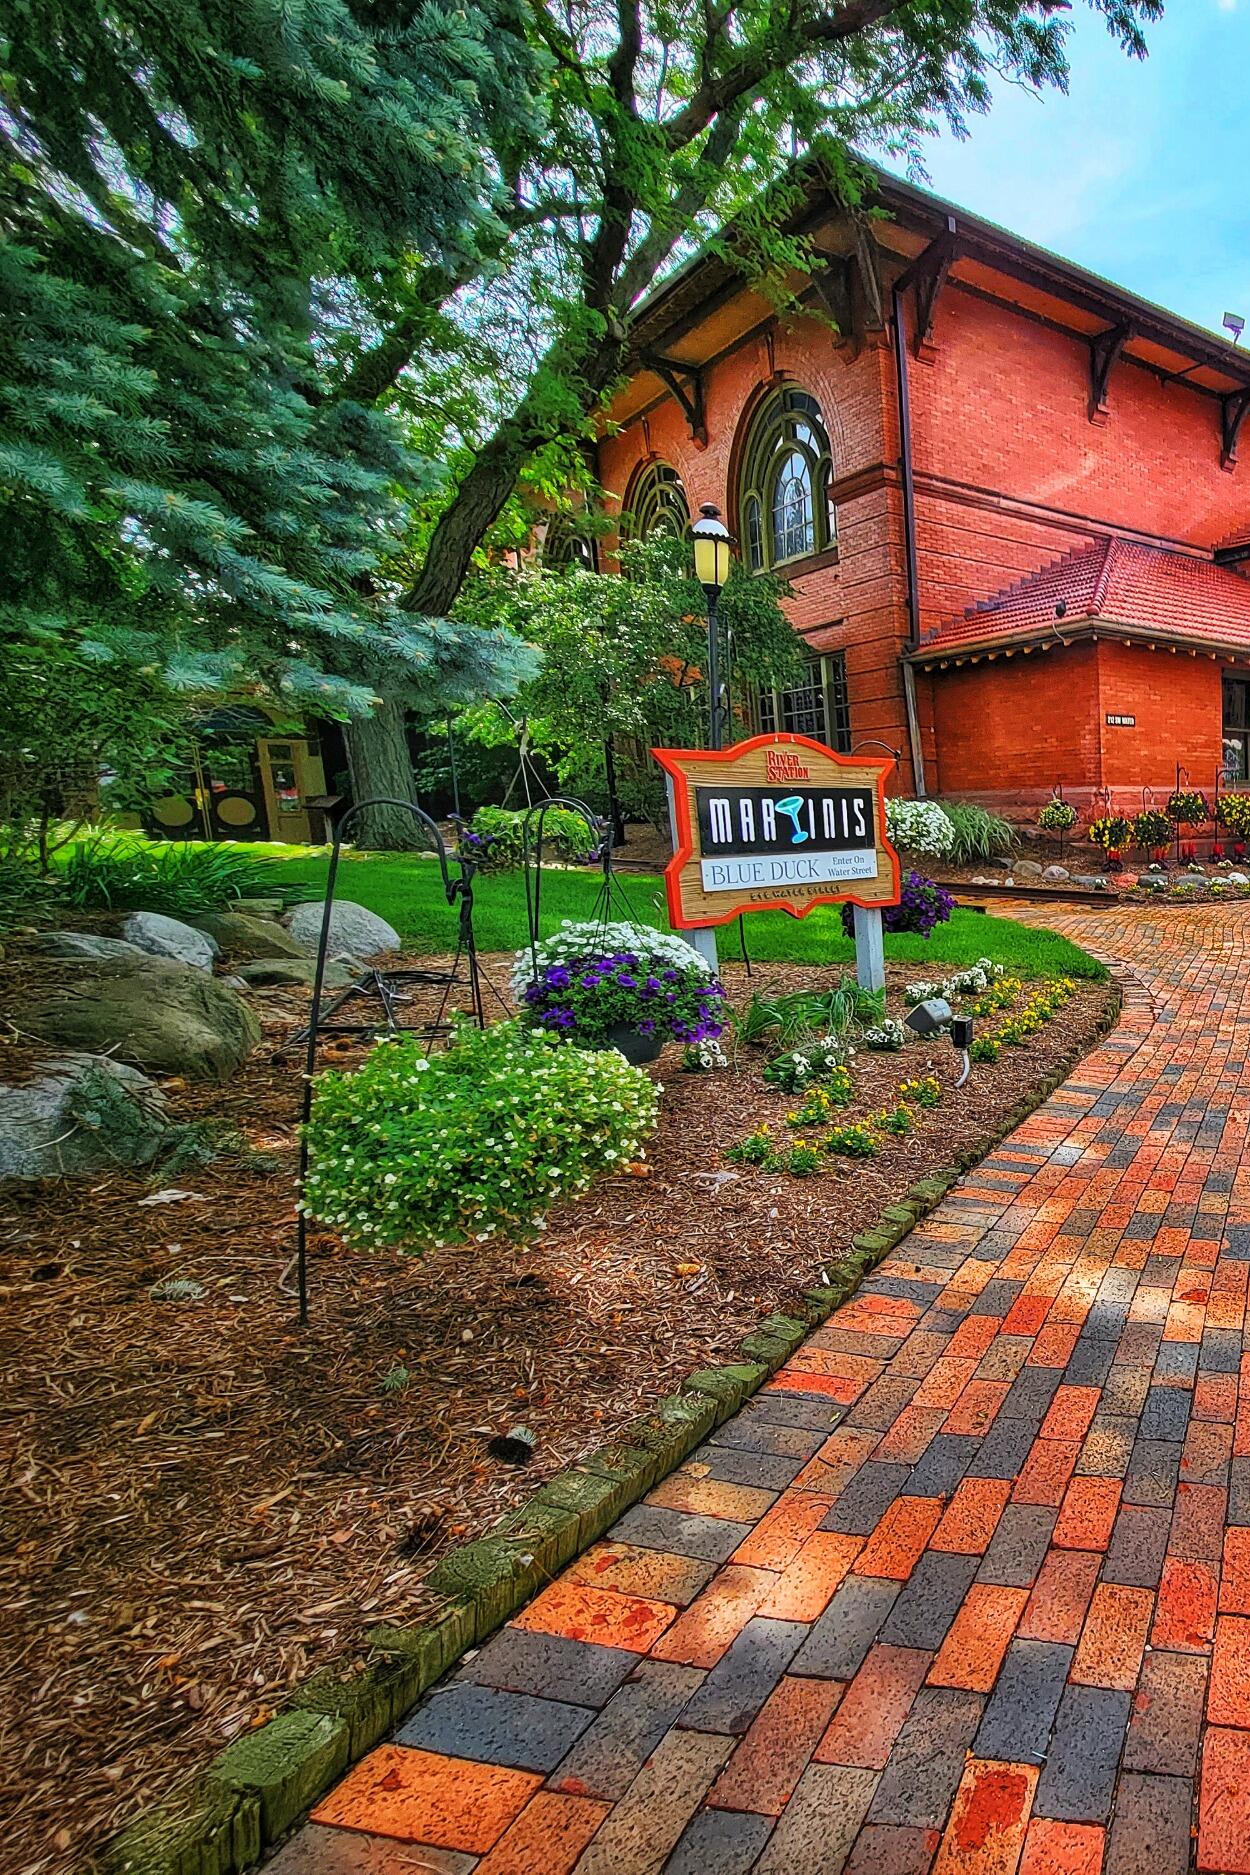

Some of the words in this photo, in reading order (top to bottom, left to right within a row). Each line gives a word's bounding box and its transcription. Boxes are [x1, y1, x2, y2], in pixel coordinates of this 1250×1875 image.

[767, 750, 800, 767] RIVER
[768, 766, 809, 781] STATION
[709, 796, 866, 844] MARTINIS
[832, 857, 852, 865] Enter
[853, 855, 865, 864] On
[711, 863, 765, 885] BLUE
[771, 859, 820, 881] DUCK
[828, 868, 850, 877] Water
[851, 866, 873, 875] Street
